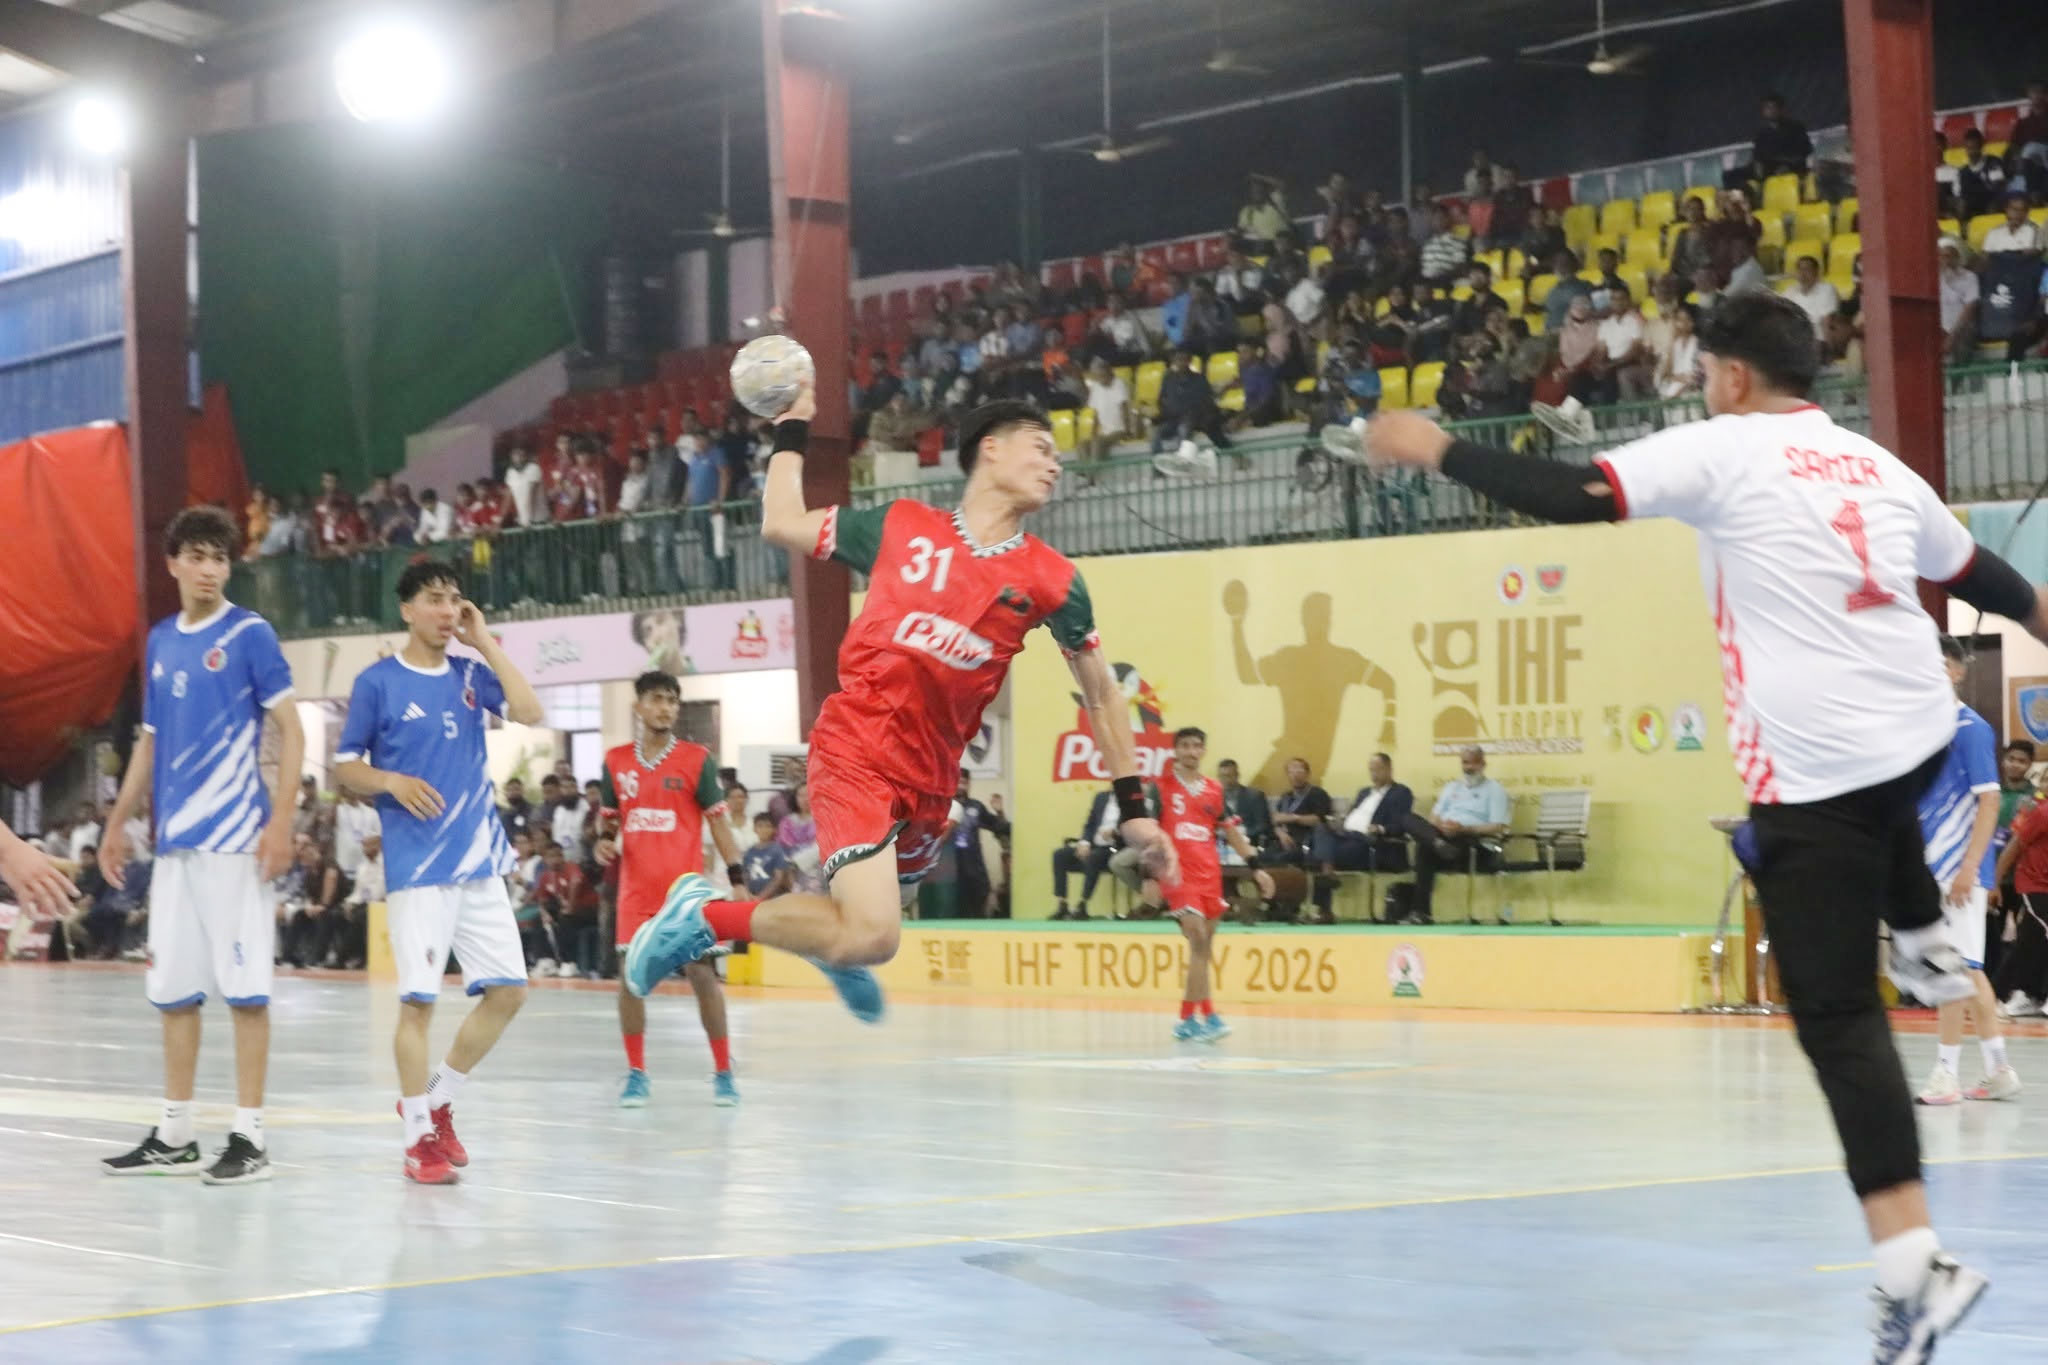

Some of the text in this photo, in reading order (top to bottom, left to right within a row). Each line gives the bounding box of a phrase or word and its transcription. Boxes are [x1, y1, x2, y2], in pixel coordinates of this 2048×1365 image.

[1784, 446, 1883, 486] SAMIR
[900, 535, 955, 592] 31
[1829, 498, 1896, 614] 1
[903, 618, 983, 664] Polar
[1497, 615, 1583, 705] IHF
[441, 710, 459, 739] 5
[1497, 708, 1584, 738] TROPHY
[1058, 734, 1176, 779] Poar
[1171, 793, 1186, 815] 5
[1003, 941, 1062, 986] IHF
[1245, 947, 1337, 993] 2026
